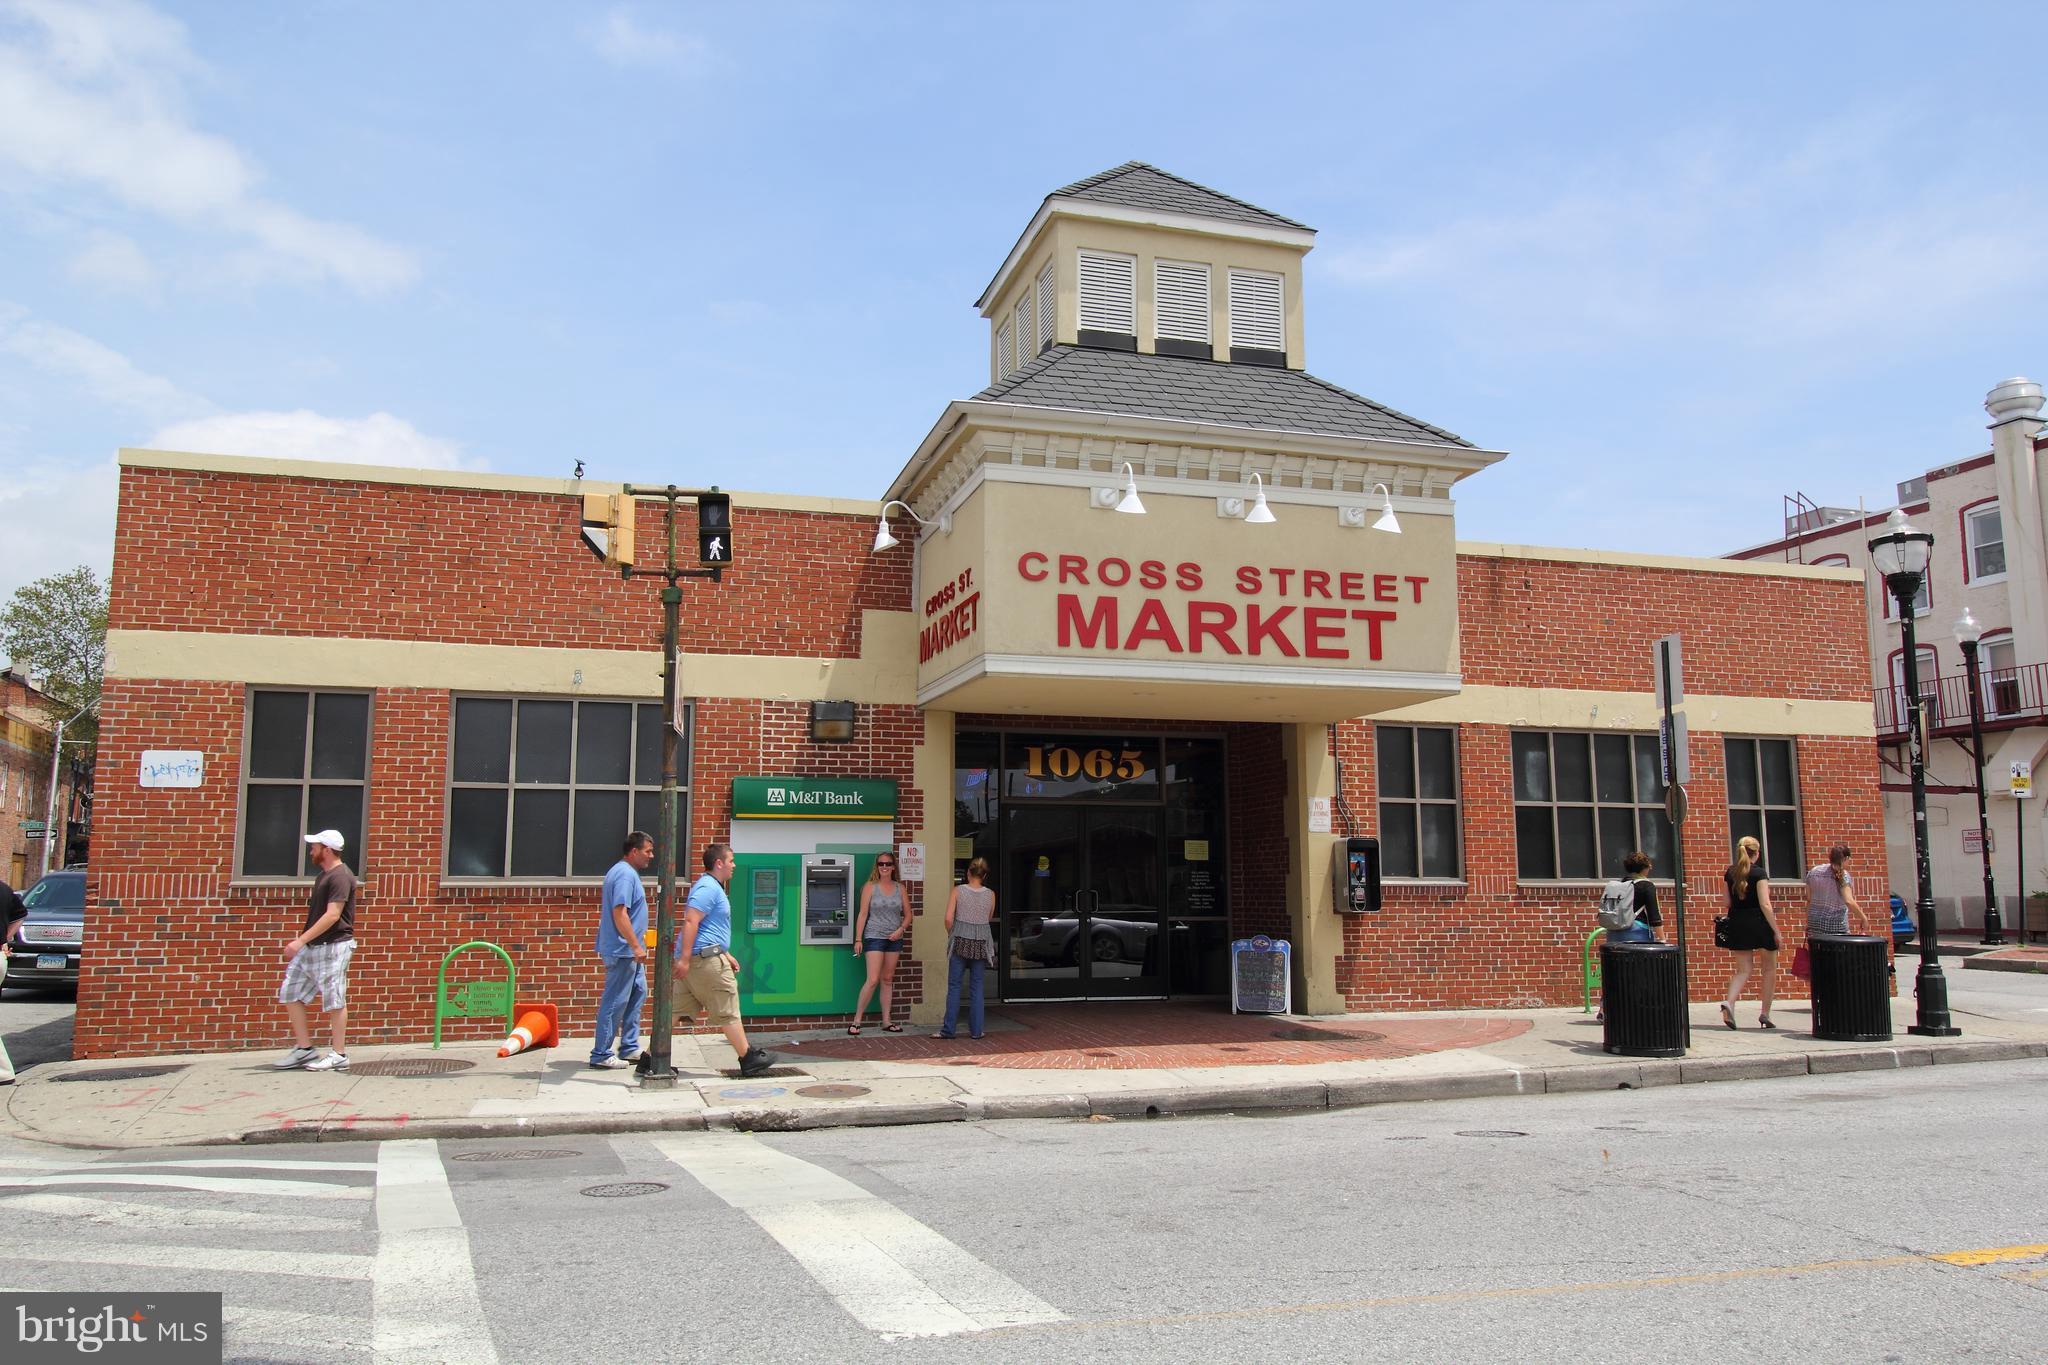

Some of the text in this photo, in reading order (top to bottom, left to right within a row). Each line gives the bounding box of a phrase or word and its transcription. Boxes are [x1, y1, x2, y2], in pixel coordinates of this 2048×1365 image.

[925, 567, 974, 617] CROSS ST.
[1018, 551, 1429, 604] CROSS STREET
[919, 591, 980, 664] MARKET
[1057, 592, 1397, 661] MARKET
[1023, 745, 1146, 780] 1065
[789, 790, 864, 805] M&T Bank
[907, 847, 918, 857] NO
